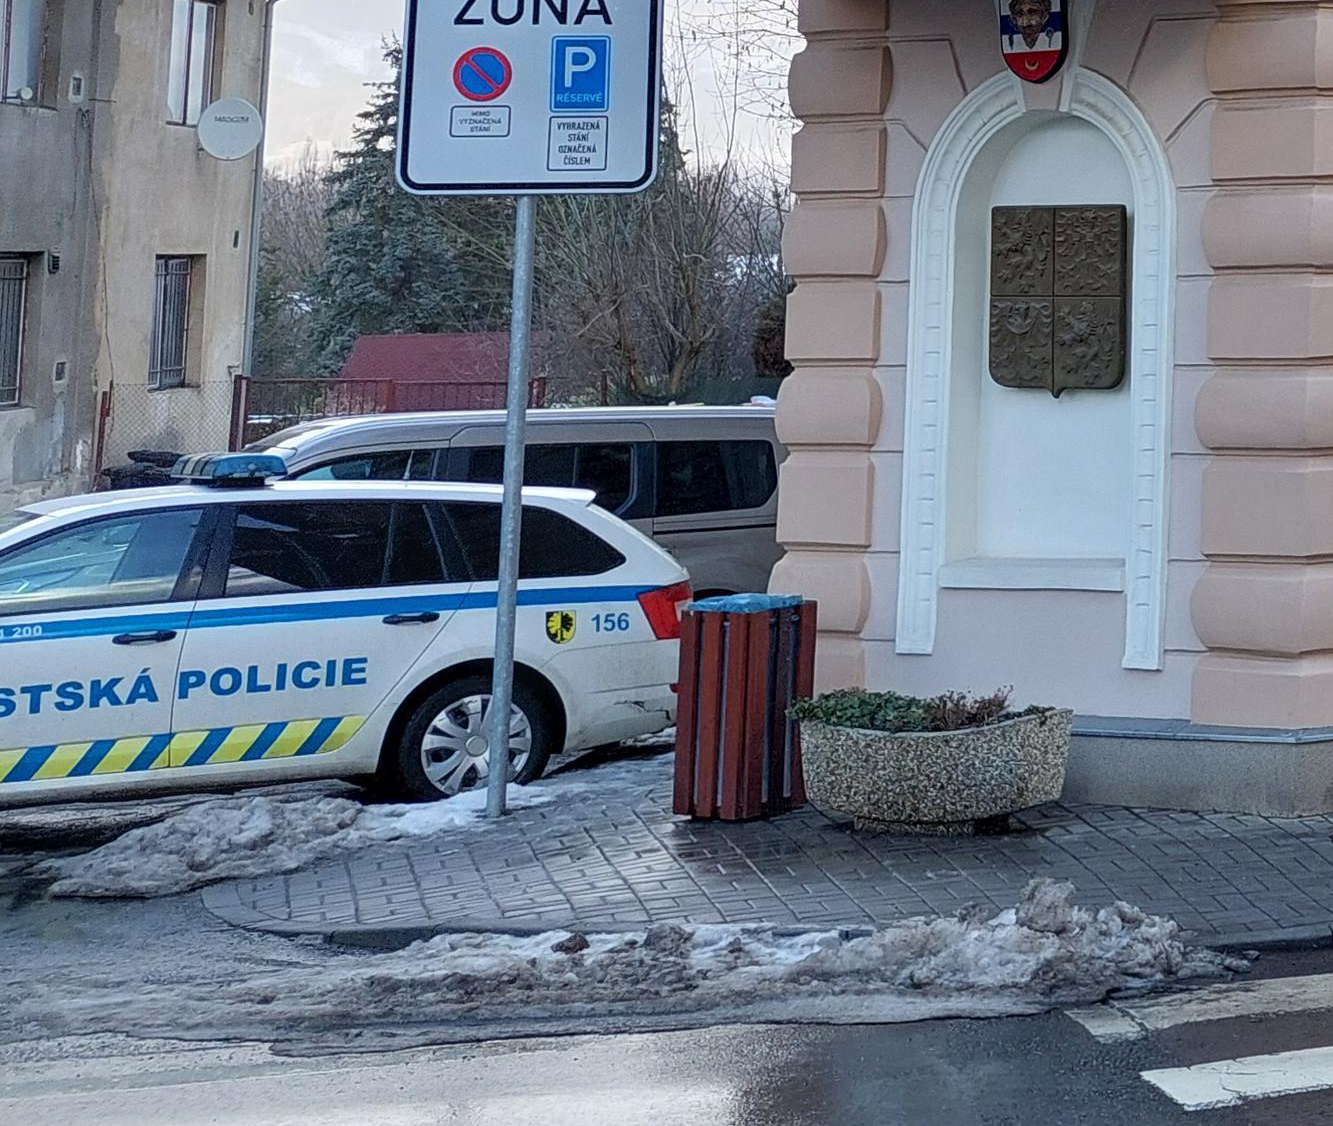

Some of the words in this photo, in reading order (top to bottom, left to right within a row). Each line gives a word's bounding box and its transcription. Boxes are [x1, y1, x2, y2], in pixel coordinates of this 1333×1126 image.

[564, 46, 597, 88] P
[556, 92, 603, 103] RÉSERVÉ
[557, 120, 601, 130] VYHRAZENÁ
[567, 131, 590, 142] STÁNÍ
[558, 143, 597, 154] OZNAČENÁ
[563, 155, 591, 165] ČÍSLEM
[591, 612, 630, 632] 156
[12, 625, 43, 638] 200
[177, 657, 368, 700] POLICIE
